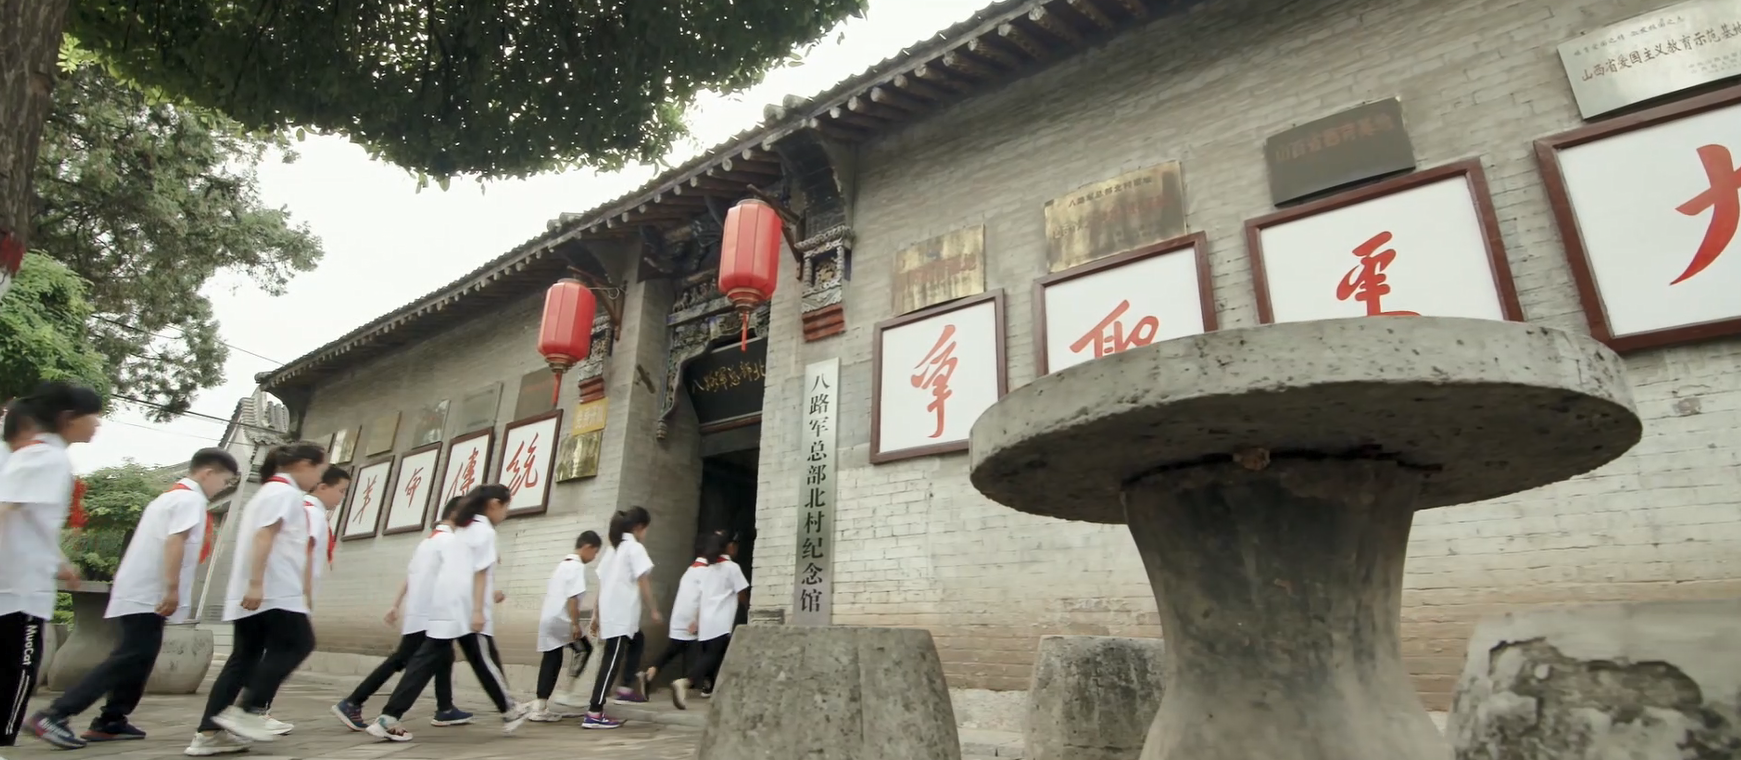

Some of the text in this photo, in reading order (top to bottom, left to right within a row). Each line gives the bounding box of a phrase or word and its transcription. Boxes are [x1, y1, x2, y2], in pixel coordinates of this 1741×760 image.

[1581, 20, 1741, 82] 山西省爱国主义教育示范基地
[799, 372, 831, 613] 八路军总部北村纪念馆
